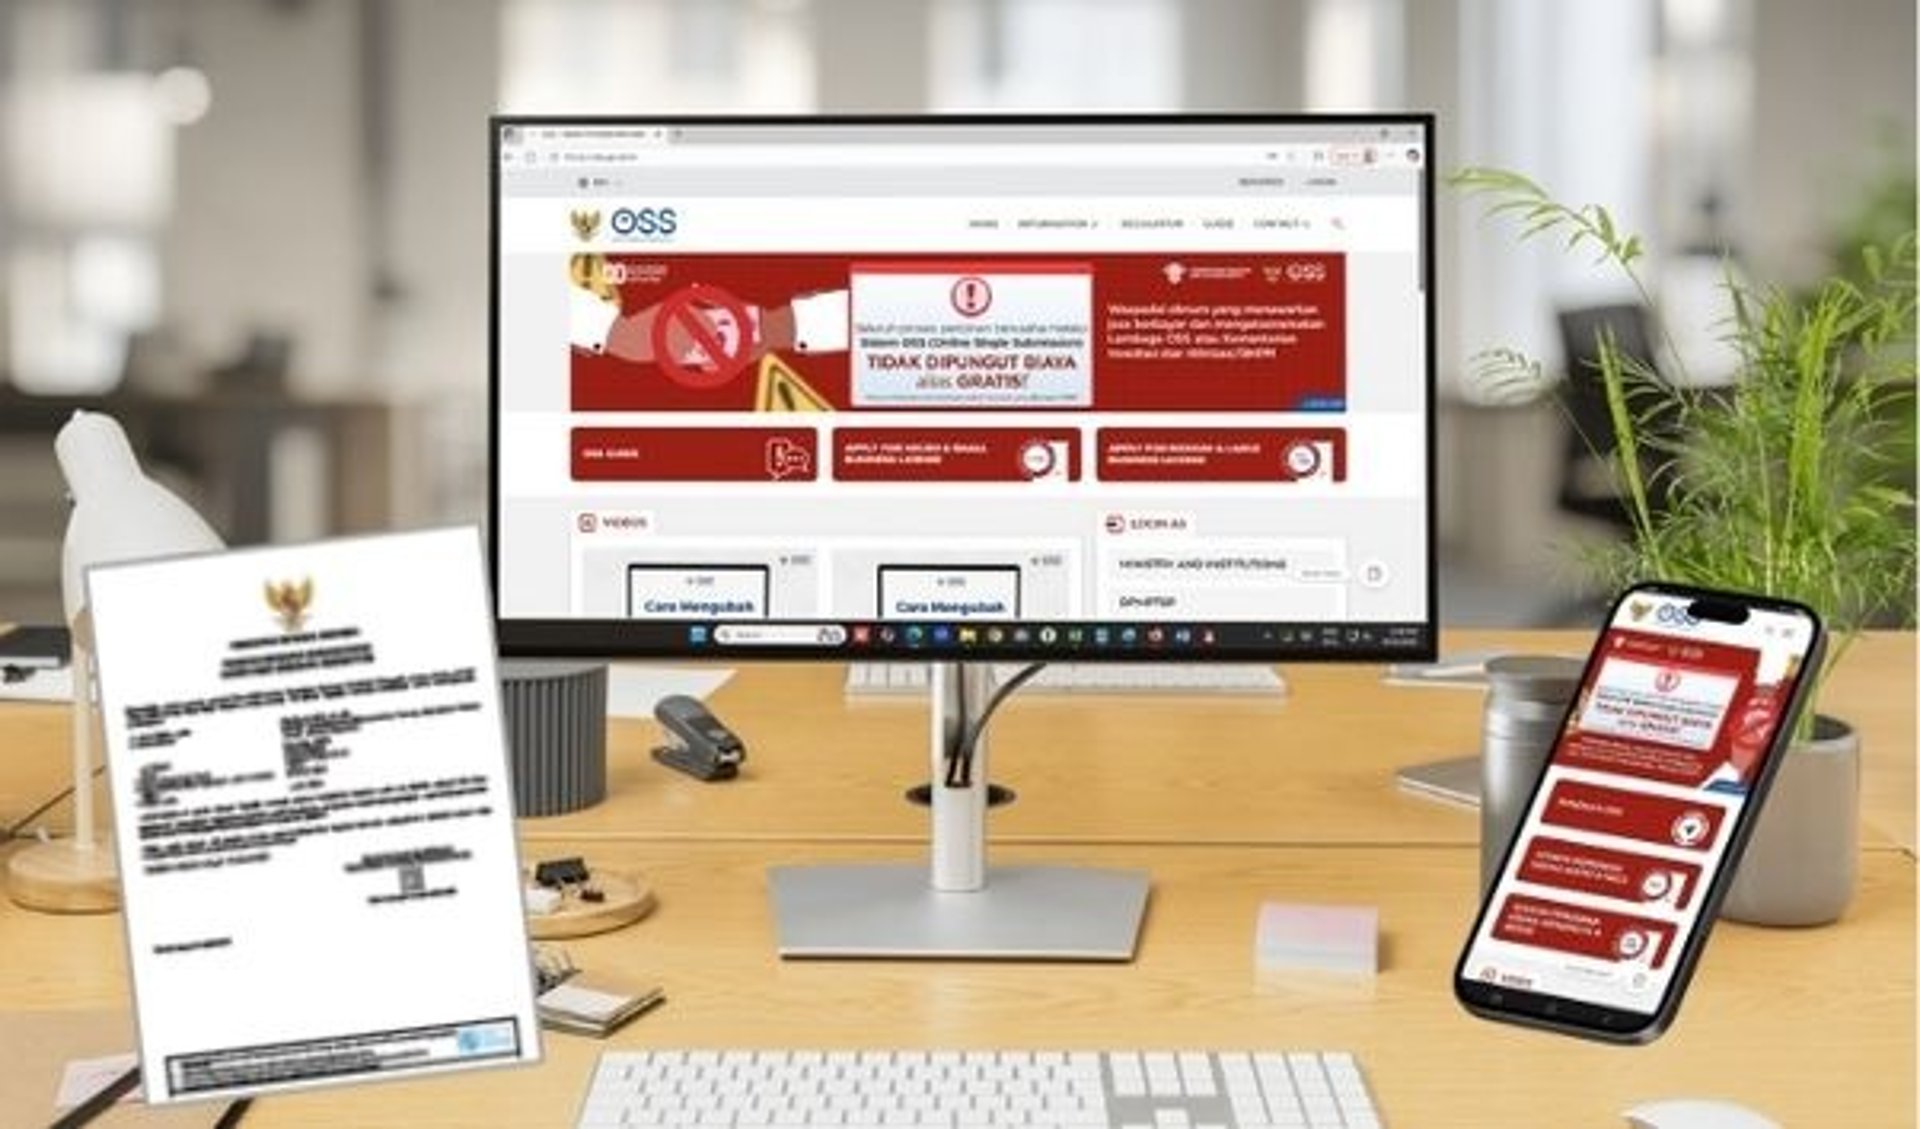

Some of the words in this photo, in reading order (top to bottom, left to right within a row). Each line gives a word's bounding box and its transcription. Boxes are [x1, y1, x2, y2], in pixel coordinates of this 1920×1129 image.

[611, 207, 677, 235] OSS
[867, 354, 921, 370] TIDAK
[925, 354, 1019, 370] DIPUNGUT
[643, 600, 677, 613] Cara
[679, 600, 755, 616] Mengubah
[895, 601, 929, 613] Cara
[931, 601, 1006, 616] Mengubah
